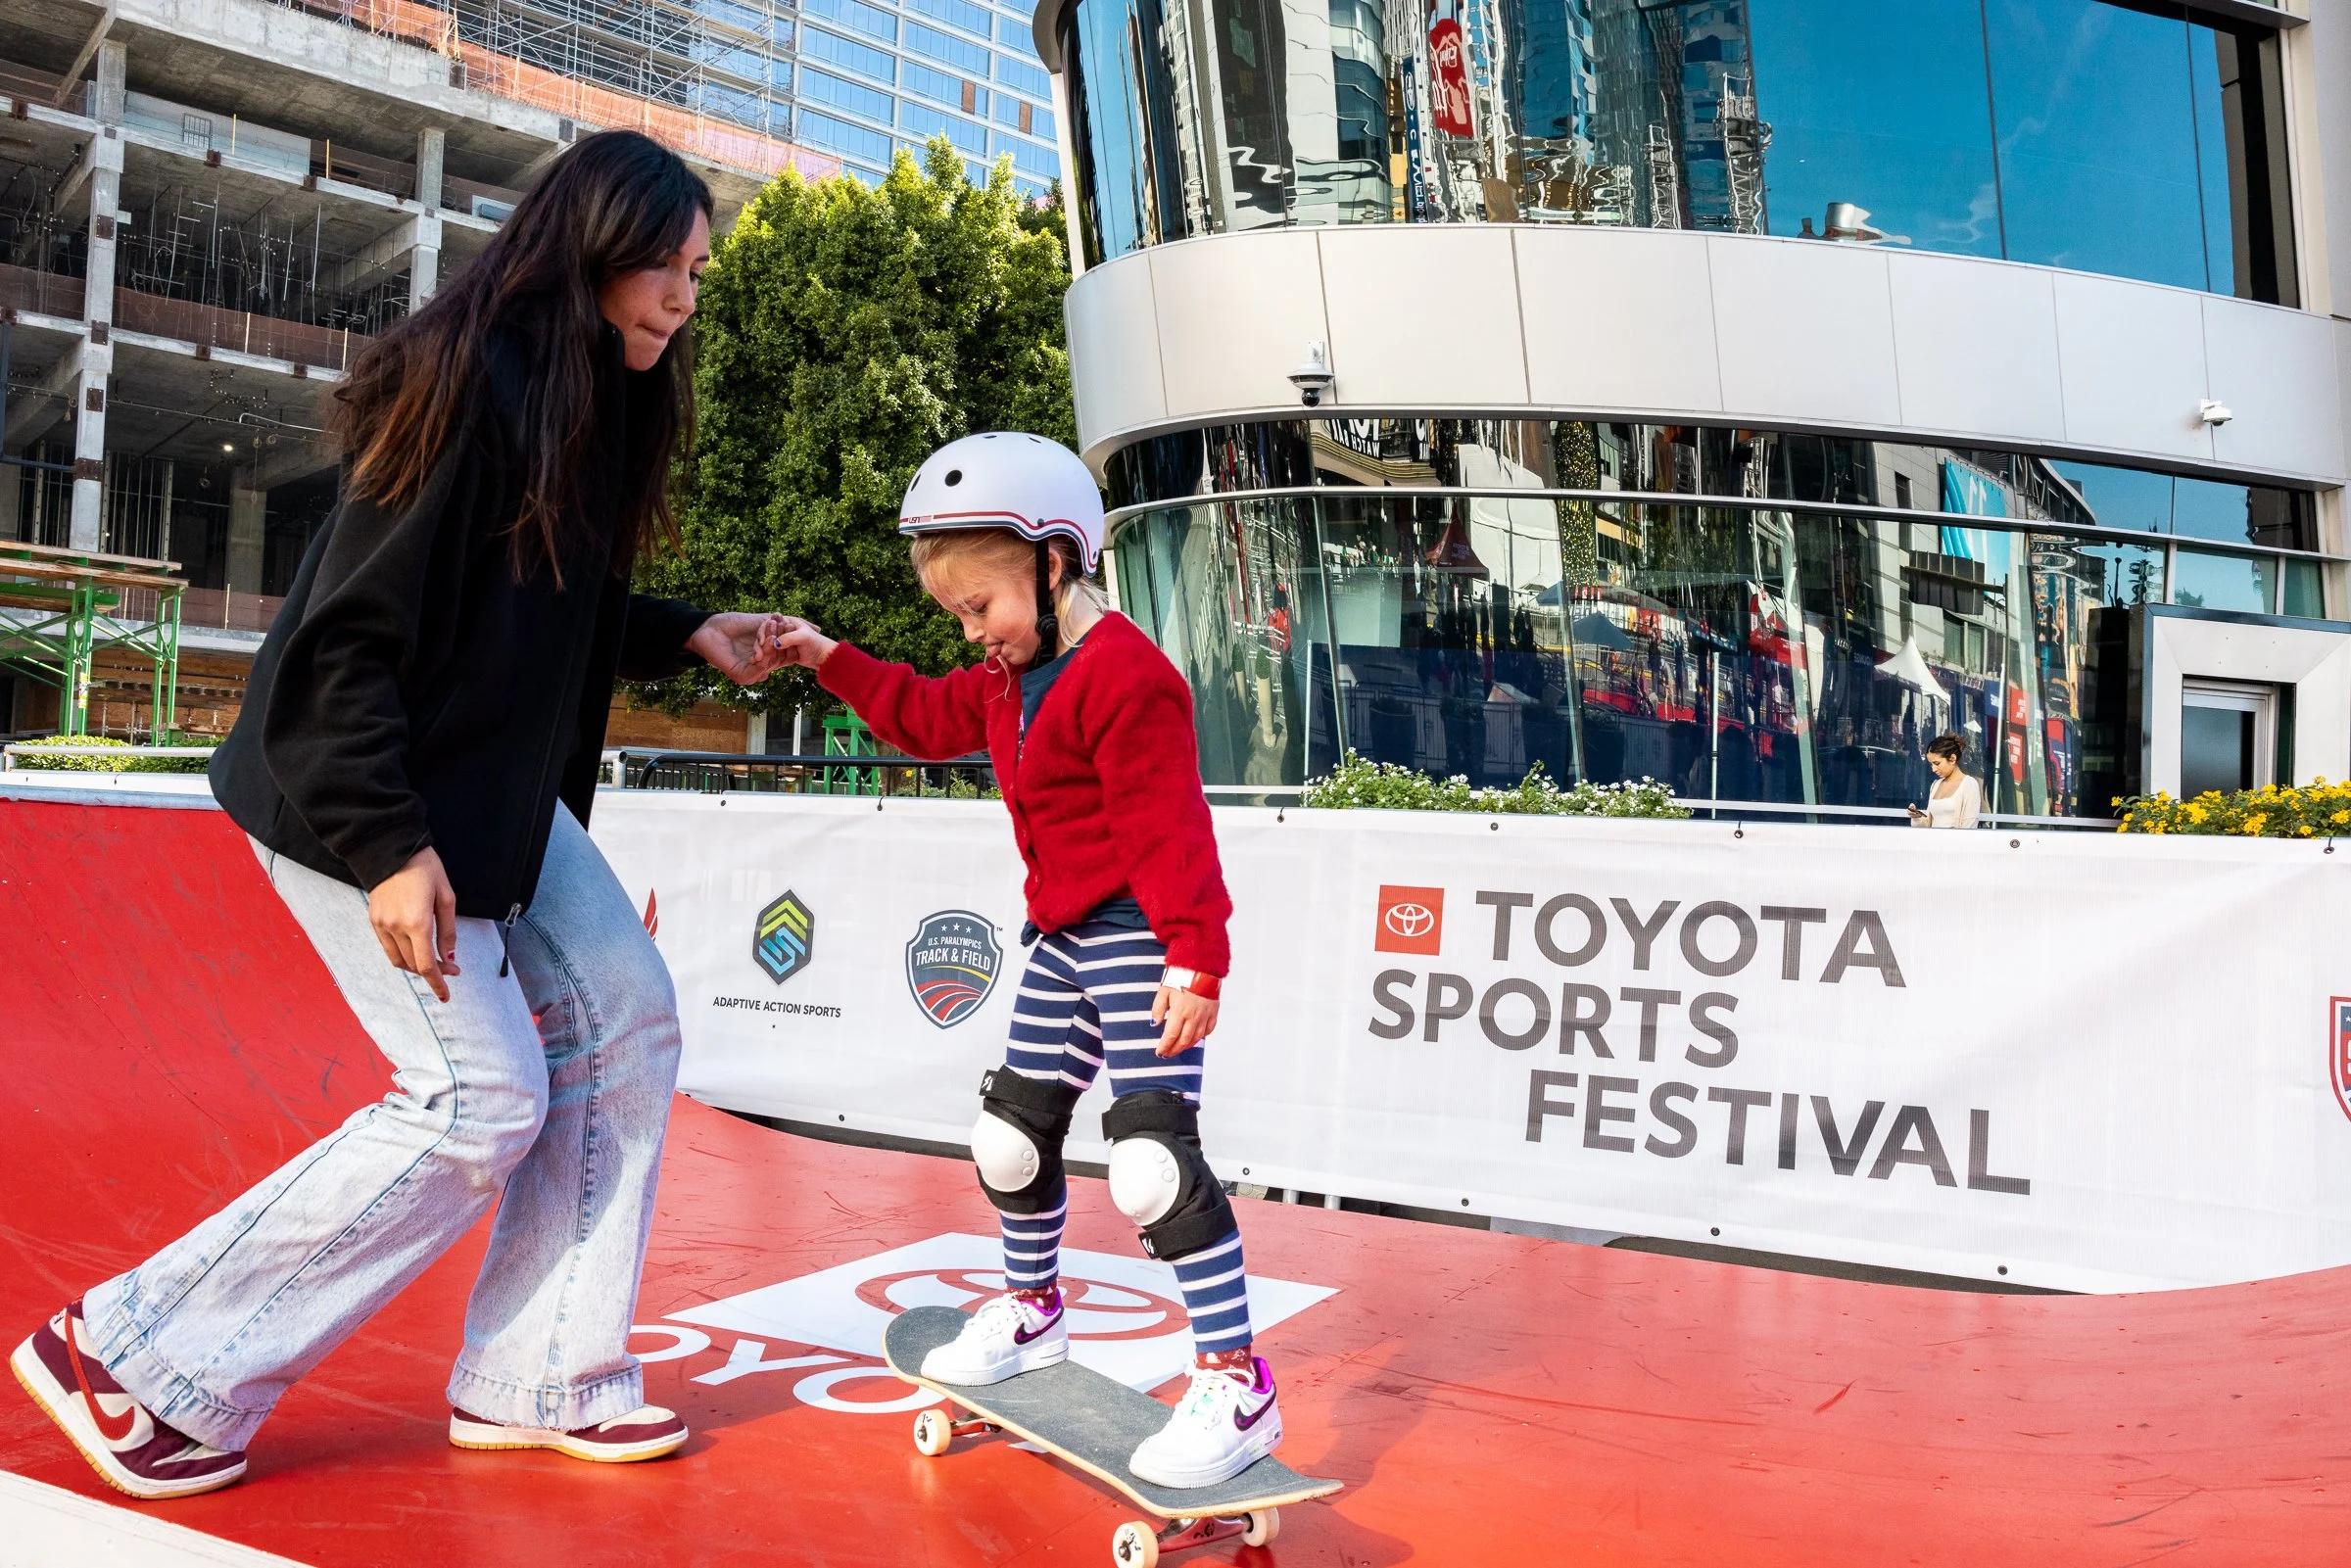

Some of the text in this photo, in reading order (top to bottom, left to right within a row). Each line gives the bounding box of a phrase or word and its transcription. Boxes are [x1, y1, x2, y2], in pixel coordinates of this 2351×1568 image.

[915, 947, 991, 972] TRACK & FIELD
[928, 936, 983, 950] U.S. PARALYMPICS
[1475, 889, 1907, 989] TOYOTA
[712, 996, 841, 1019] ADAPTIVE ACTION SPORTS
[1367, 968, 1740, 1069] SPORTS
[1525, 1069, 2033, 1197] FESTIVAL
